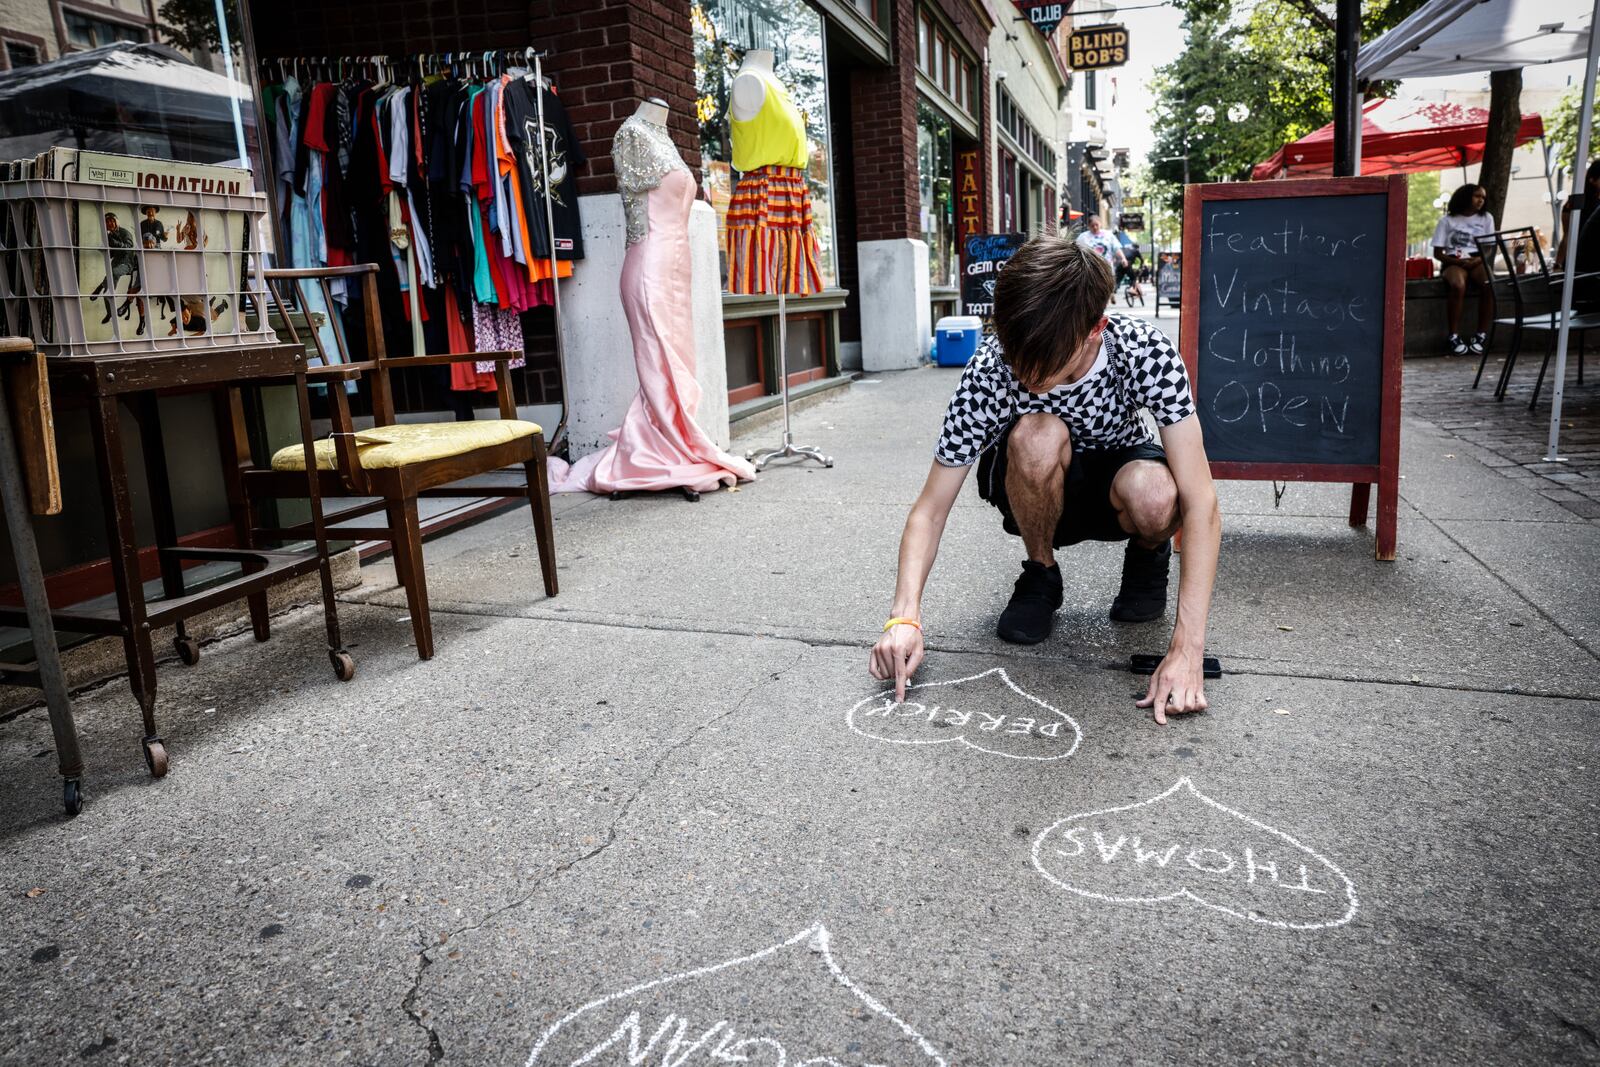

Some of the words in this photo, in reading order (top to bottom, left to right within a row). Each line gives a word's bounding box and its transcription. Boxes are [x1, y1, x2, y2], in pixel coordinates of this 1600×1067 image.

[1031, 4, 1062, 23] CLUB
[1071, 31, 1126, 51] BLIND
[1073, 47, 1125, 66] BOB'S
[961, 152, 979, 234] TATT
[967, 260, 993, 276] GEM
[966, 303, 995, 315] TATT
[1213, 268, 1366, 331] Vintage
[1208, 326, 1351, 384] Clothing
[1056, 826, 1327, 894] THOMAS
[570, 1010, 887, 1067] GAN
